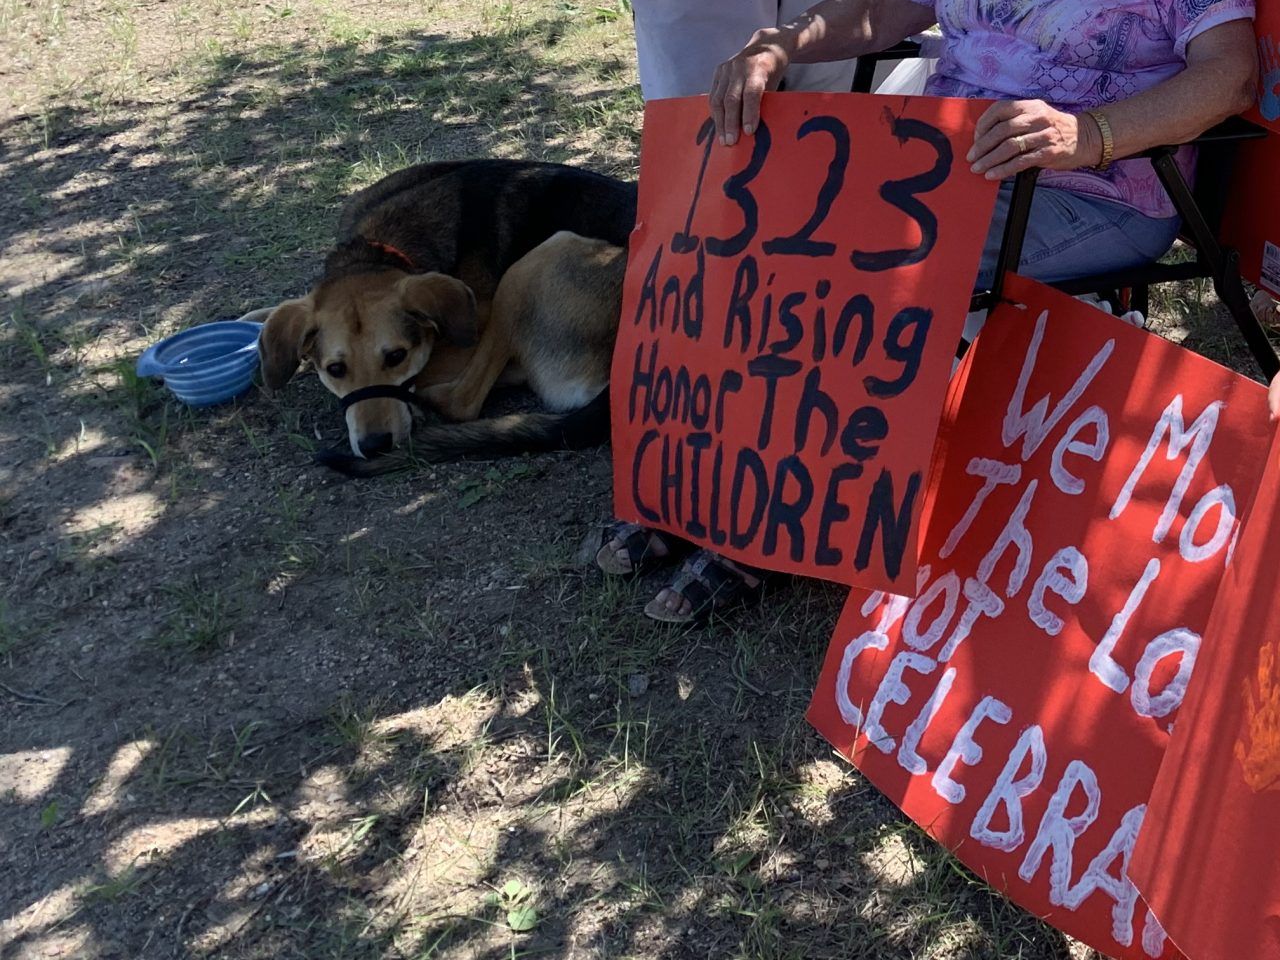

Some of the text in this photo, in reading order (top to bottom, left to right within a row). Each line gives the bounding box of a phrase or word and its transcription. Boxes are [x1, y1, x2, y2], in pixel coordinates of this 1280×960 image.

[671, 114, 954, 272] 1323
[633, 242, 934, 397] And Rising
[628, 341, 890, 462] Honor The
[1001, 309, 1241, 569] We Mo
[631, 429, 923, 582] CHILDREN
[939, 457, 1089, 636] The
[835, 630, 1168, 959] CELEBRA
